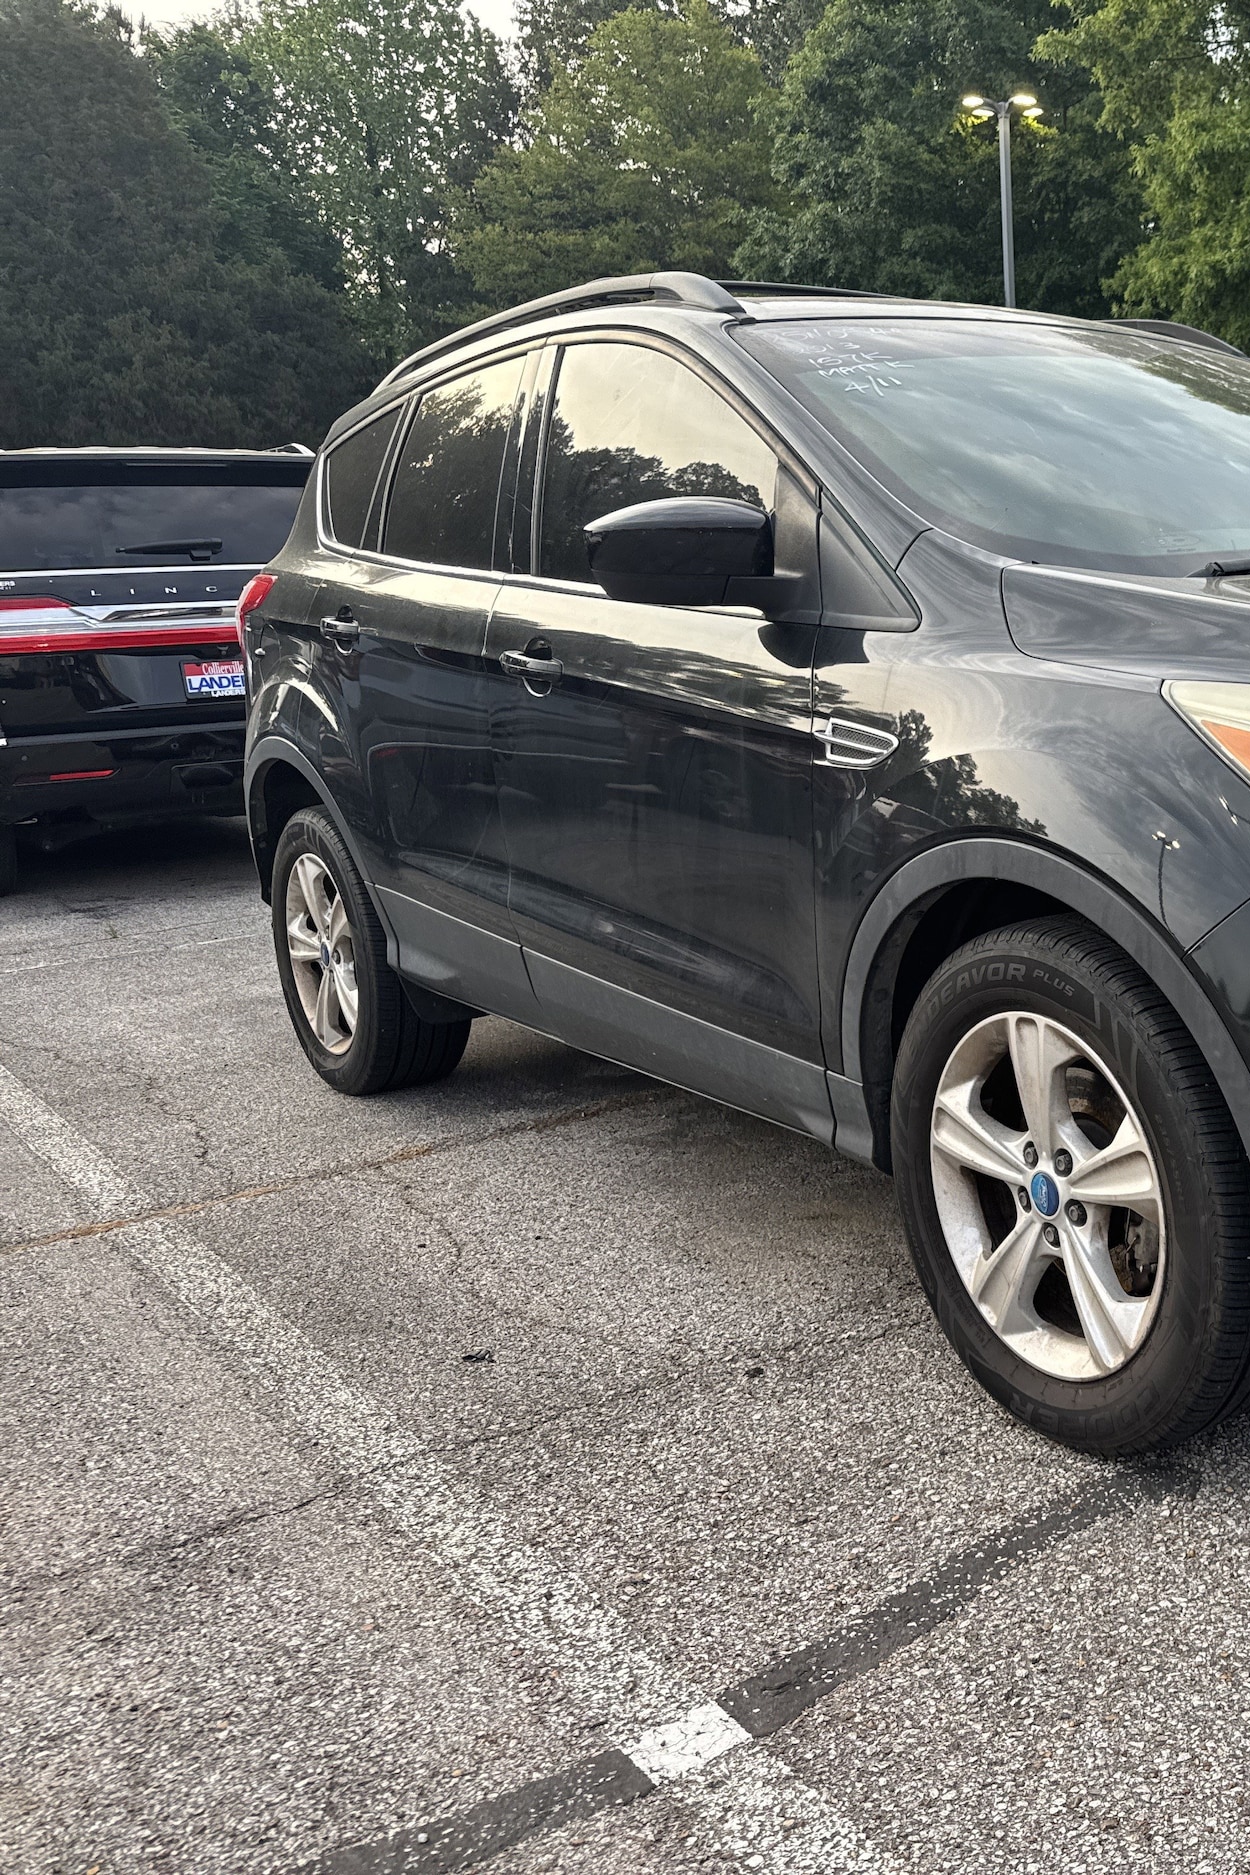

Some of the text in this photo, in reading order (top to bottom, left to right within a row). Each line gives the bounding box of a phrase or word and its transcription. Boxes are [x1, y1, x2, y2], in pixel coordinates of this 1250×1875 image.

[845, 375, 902, 397] 4/11
[90, 585, 218, 597] LINC
[202, 661, 244, 674] Collierville
[1033, 968, 1076, 998] PLUS
